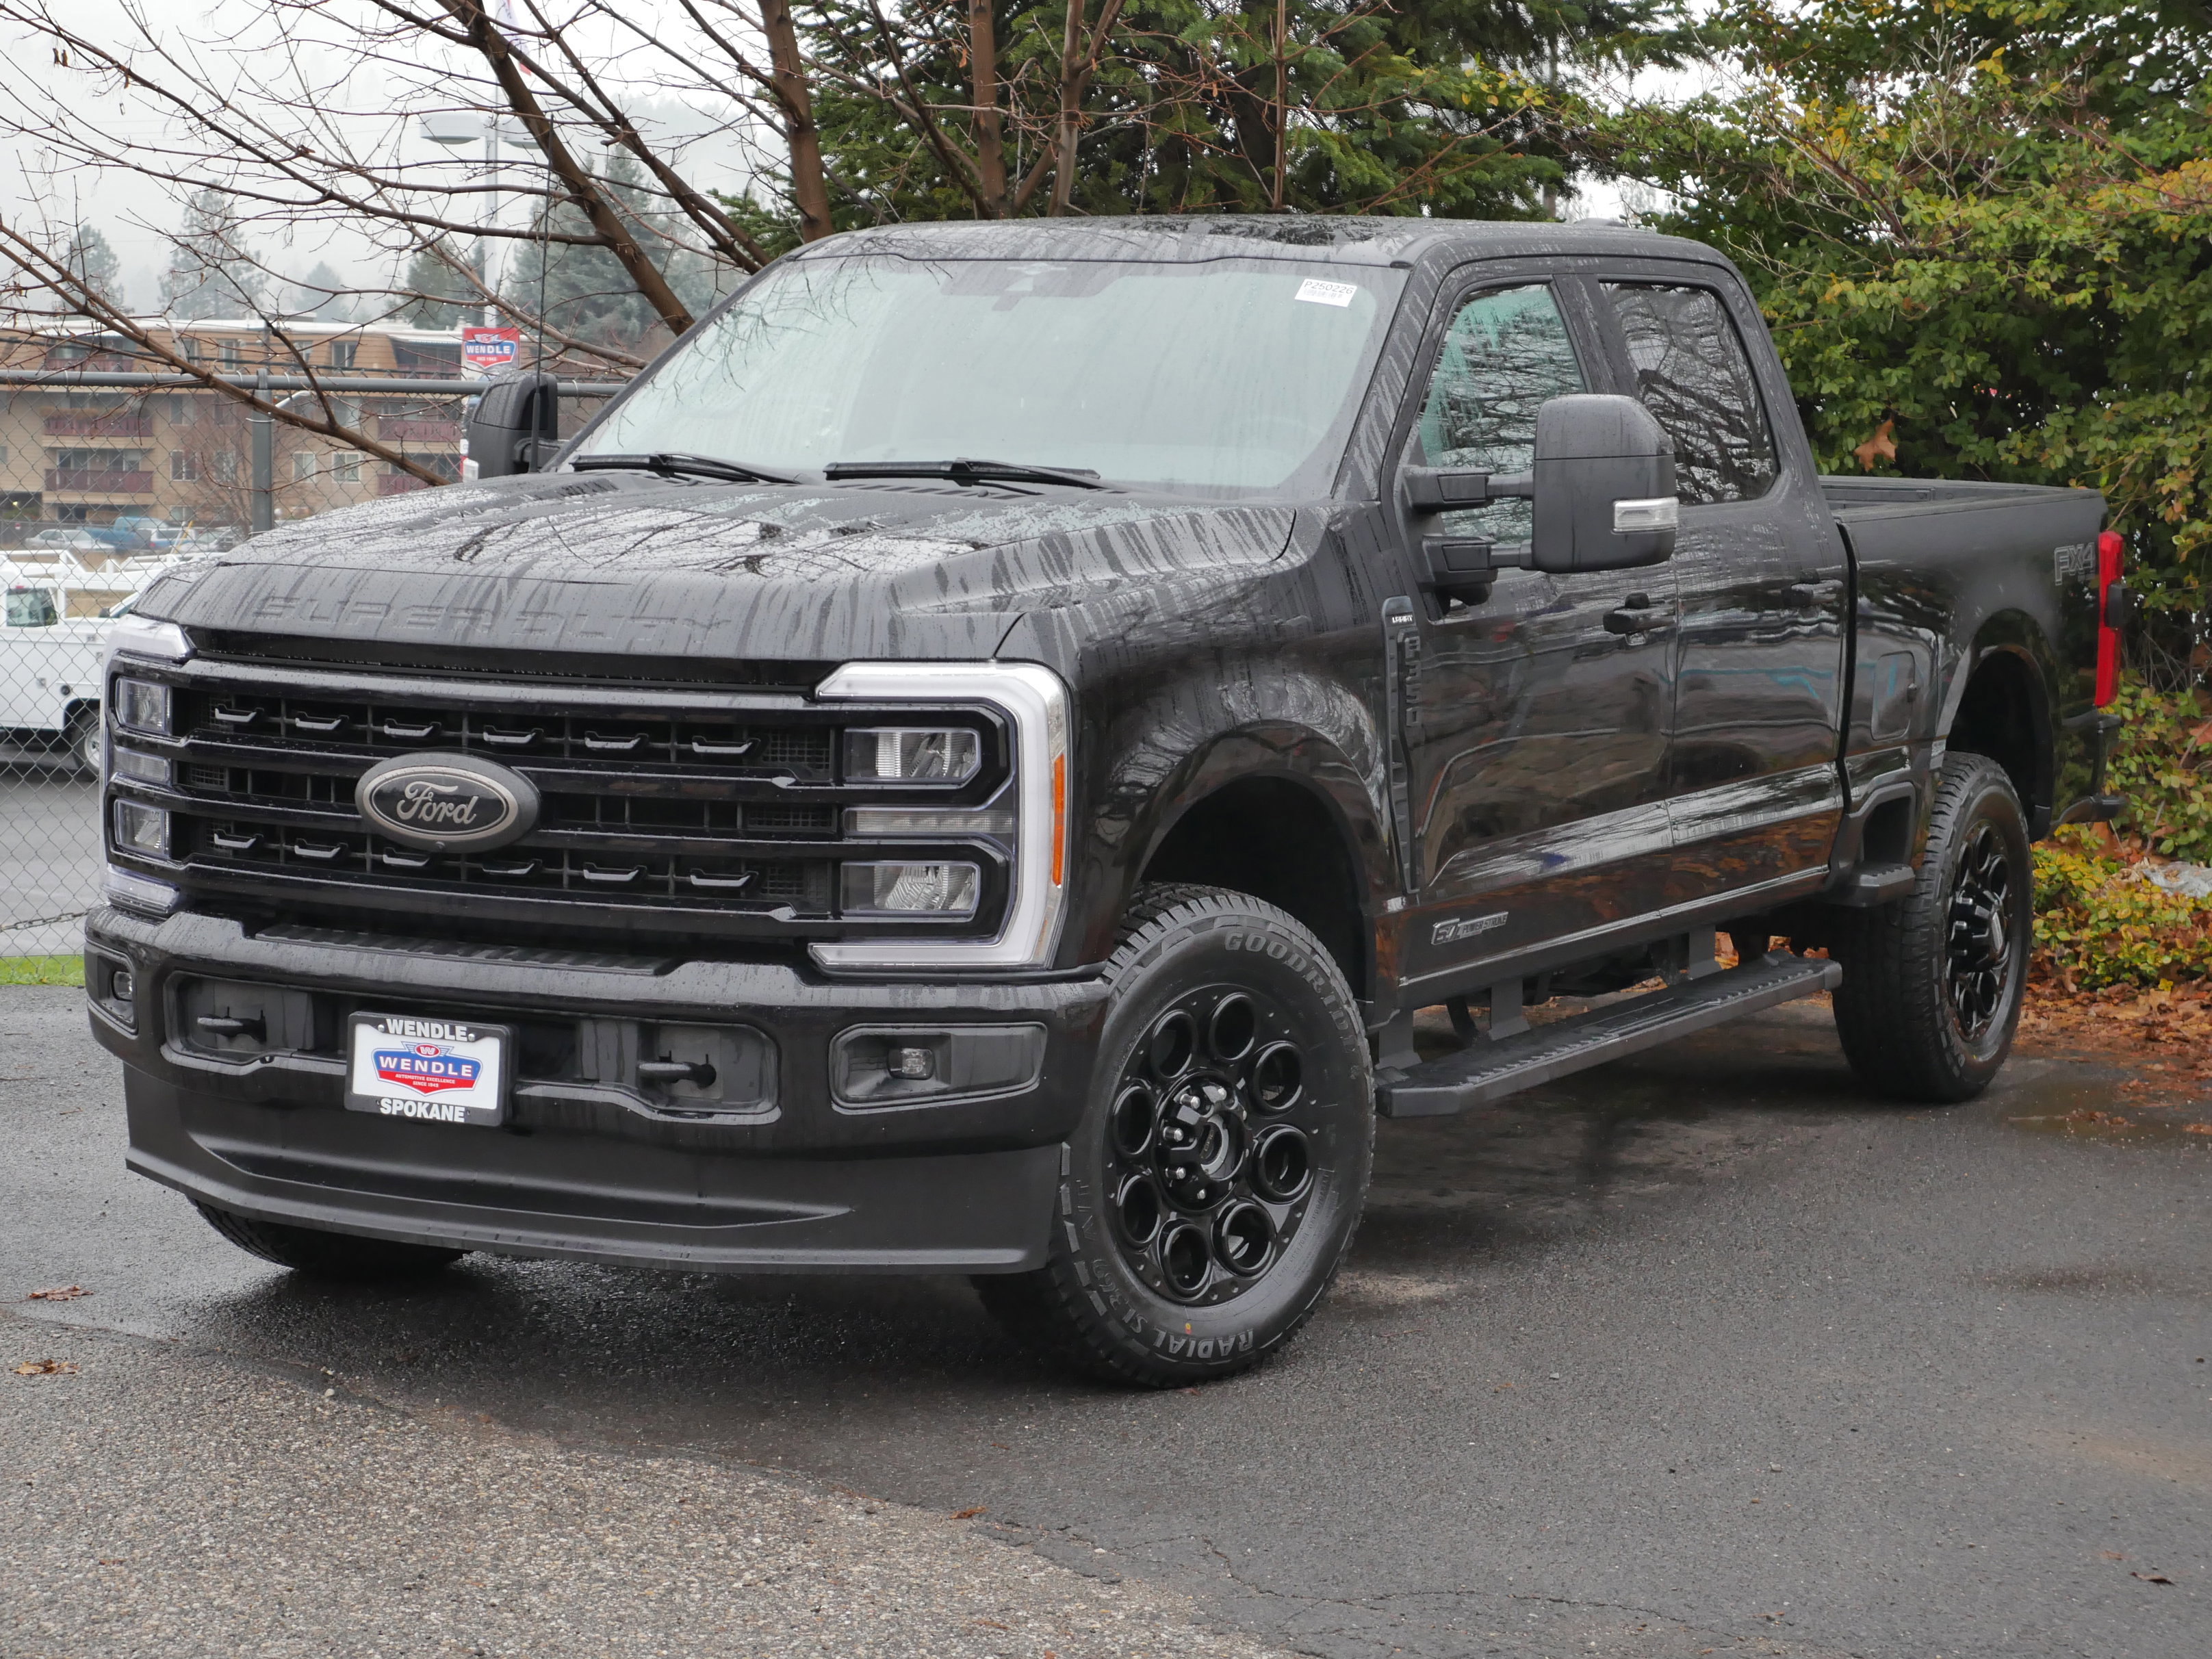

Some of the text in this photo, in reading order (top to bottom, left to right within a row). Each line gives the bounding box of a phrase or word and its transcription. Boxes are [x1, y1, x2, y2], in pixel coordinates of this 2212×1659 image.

[1304, 281, 1354, 294] P250226
[466, 346, 511, 354] WENDLE
[2054, 542, 2095, 586] FX4
[253, 595, 732, 643] SUPER DUTY
[396, 781, 478, 824] Ford
[386, 1018, 467, 1042] WENDLE
[379, 1056, 472, 1077] WENDLE
[380, 1098, 465, 1122] SPOKANE
[1151, 1326, 1254, 1359] RADIAL
